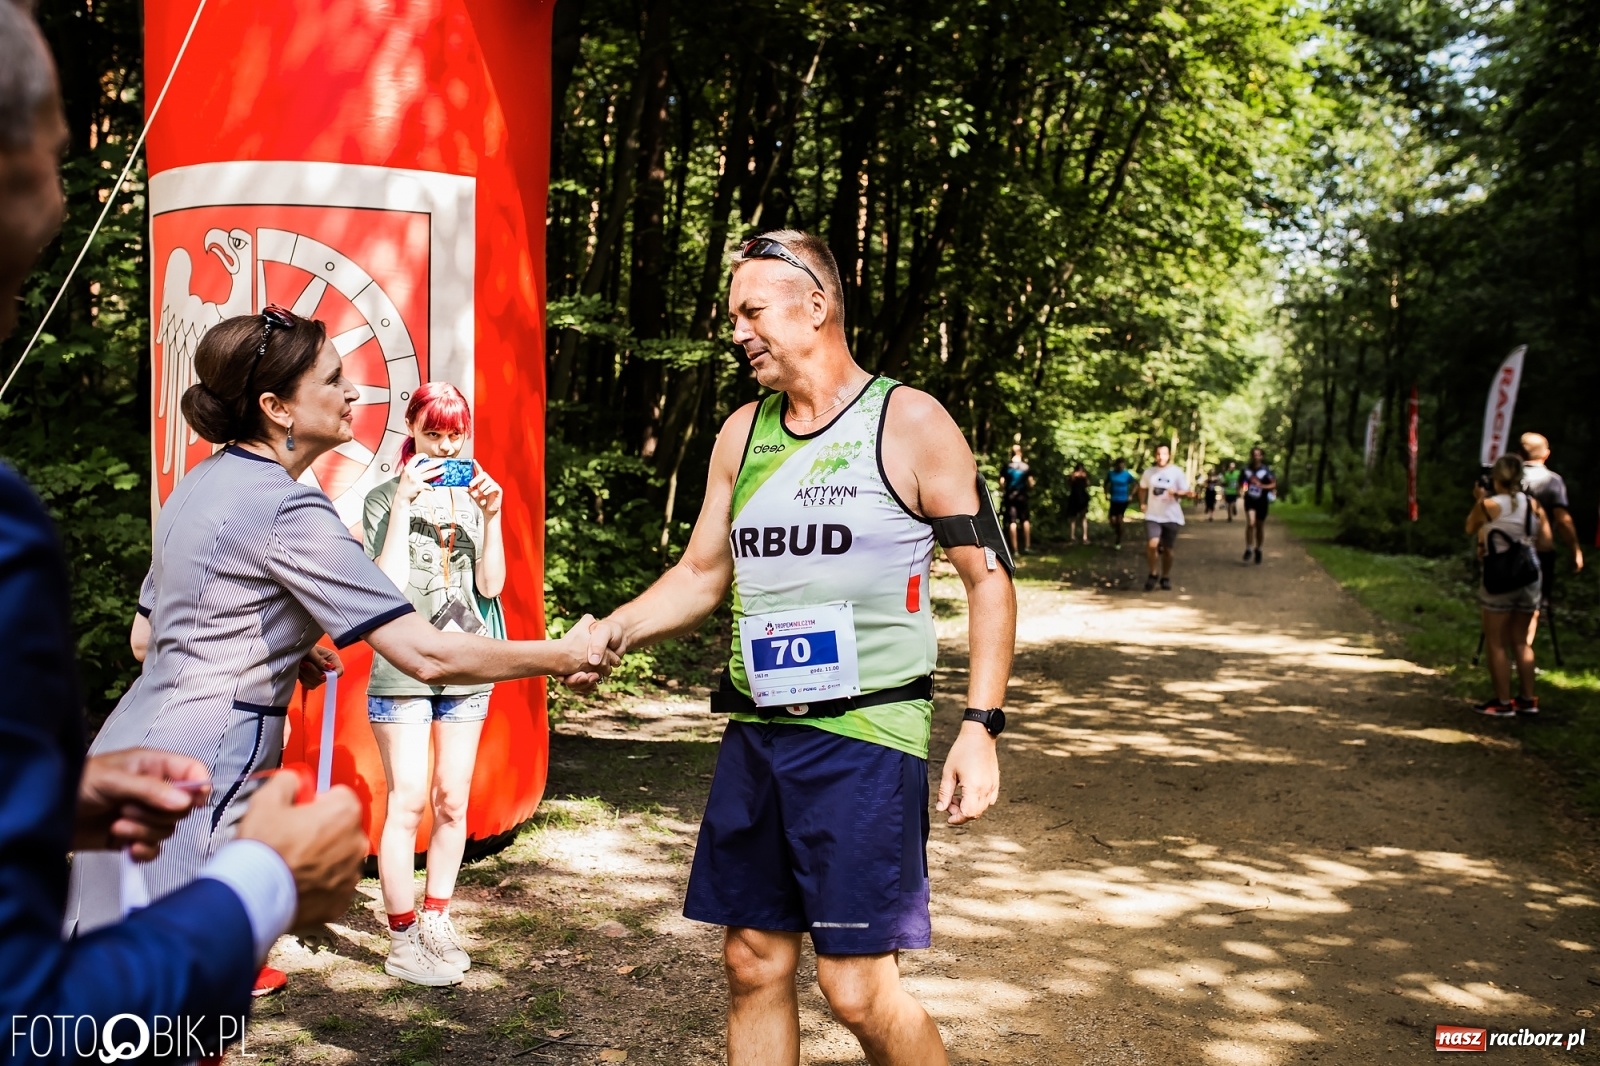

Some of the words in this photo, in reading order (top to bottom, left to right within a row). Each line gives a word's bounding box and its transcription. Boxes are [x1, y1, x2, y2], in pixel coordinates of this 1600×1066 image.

[793, 485, 858, 500] AKTYWNI
[803, 497, 844, 507] LYSKI
[770, 637, 811, 666] 70
